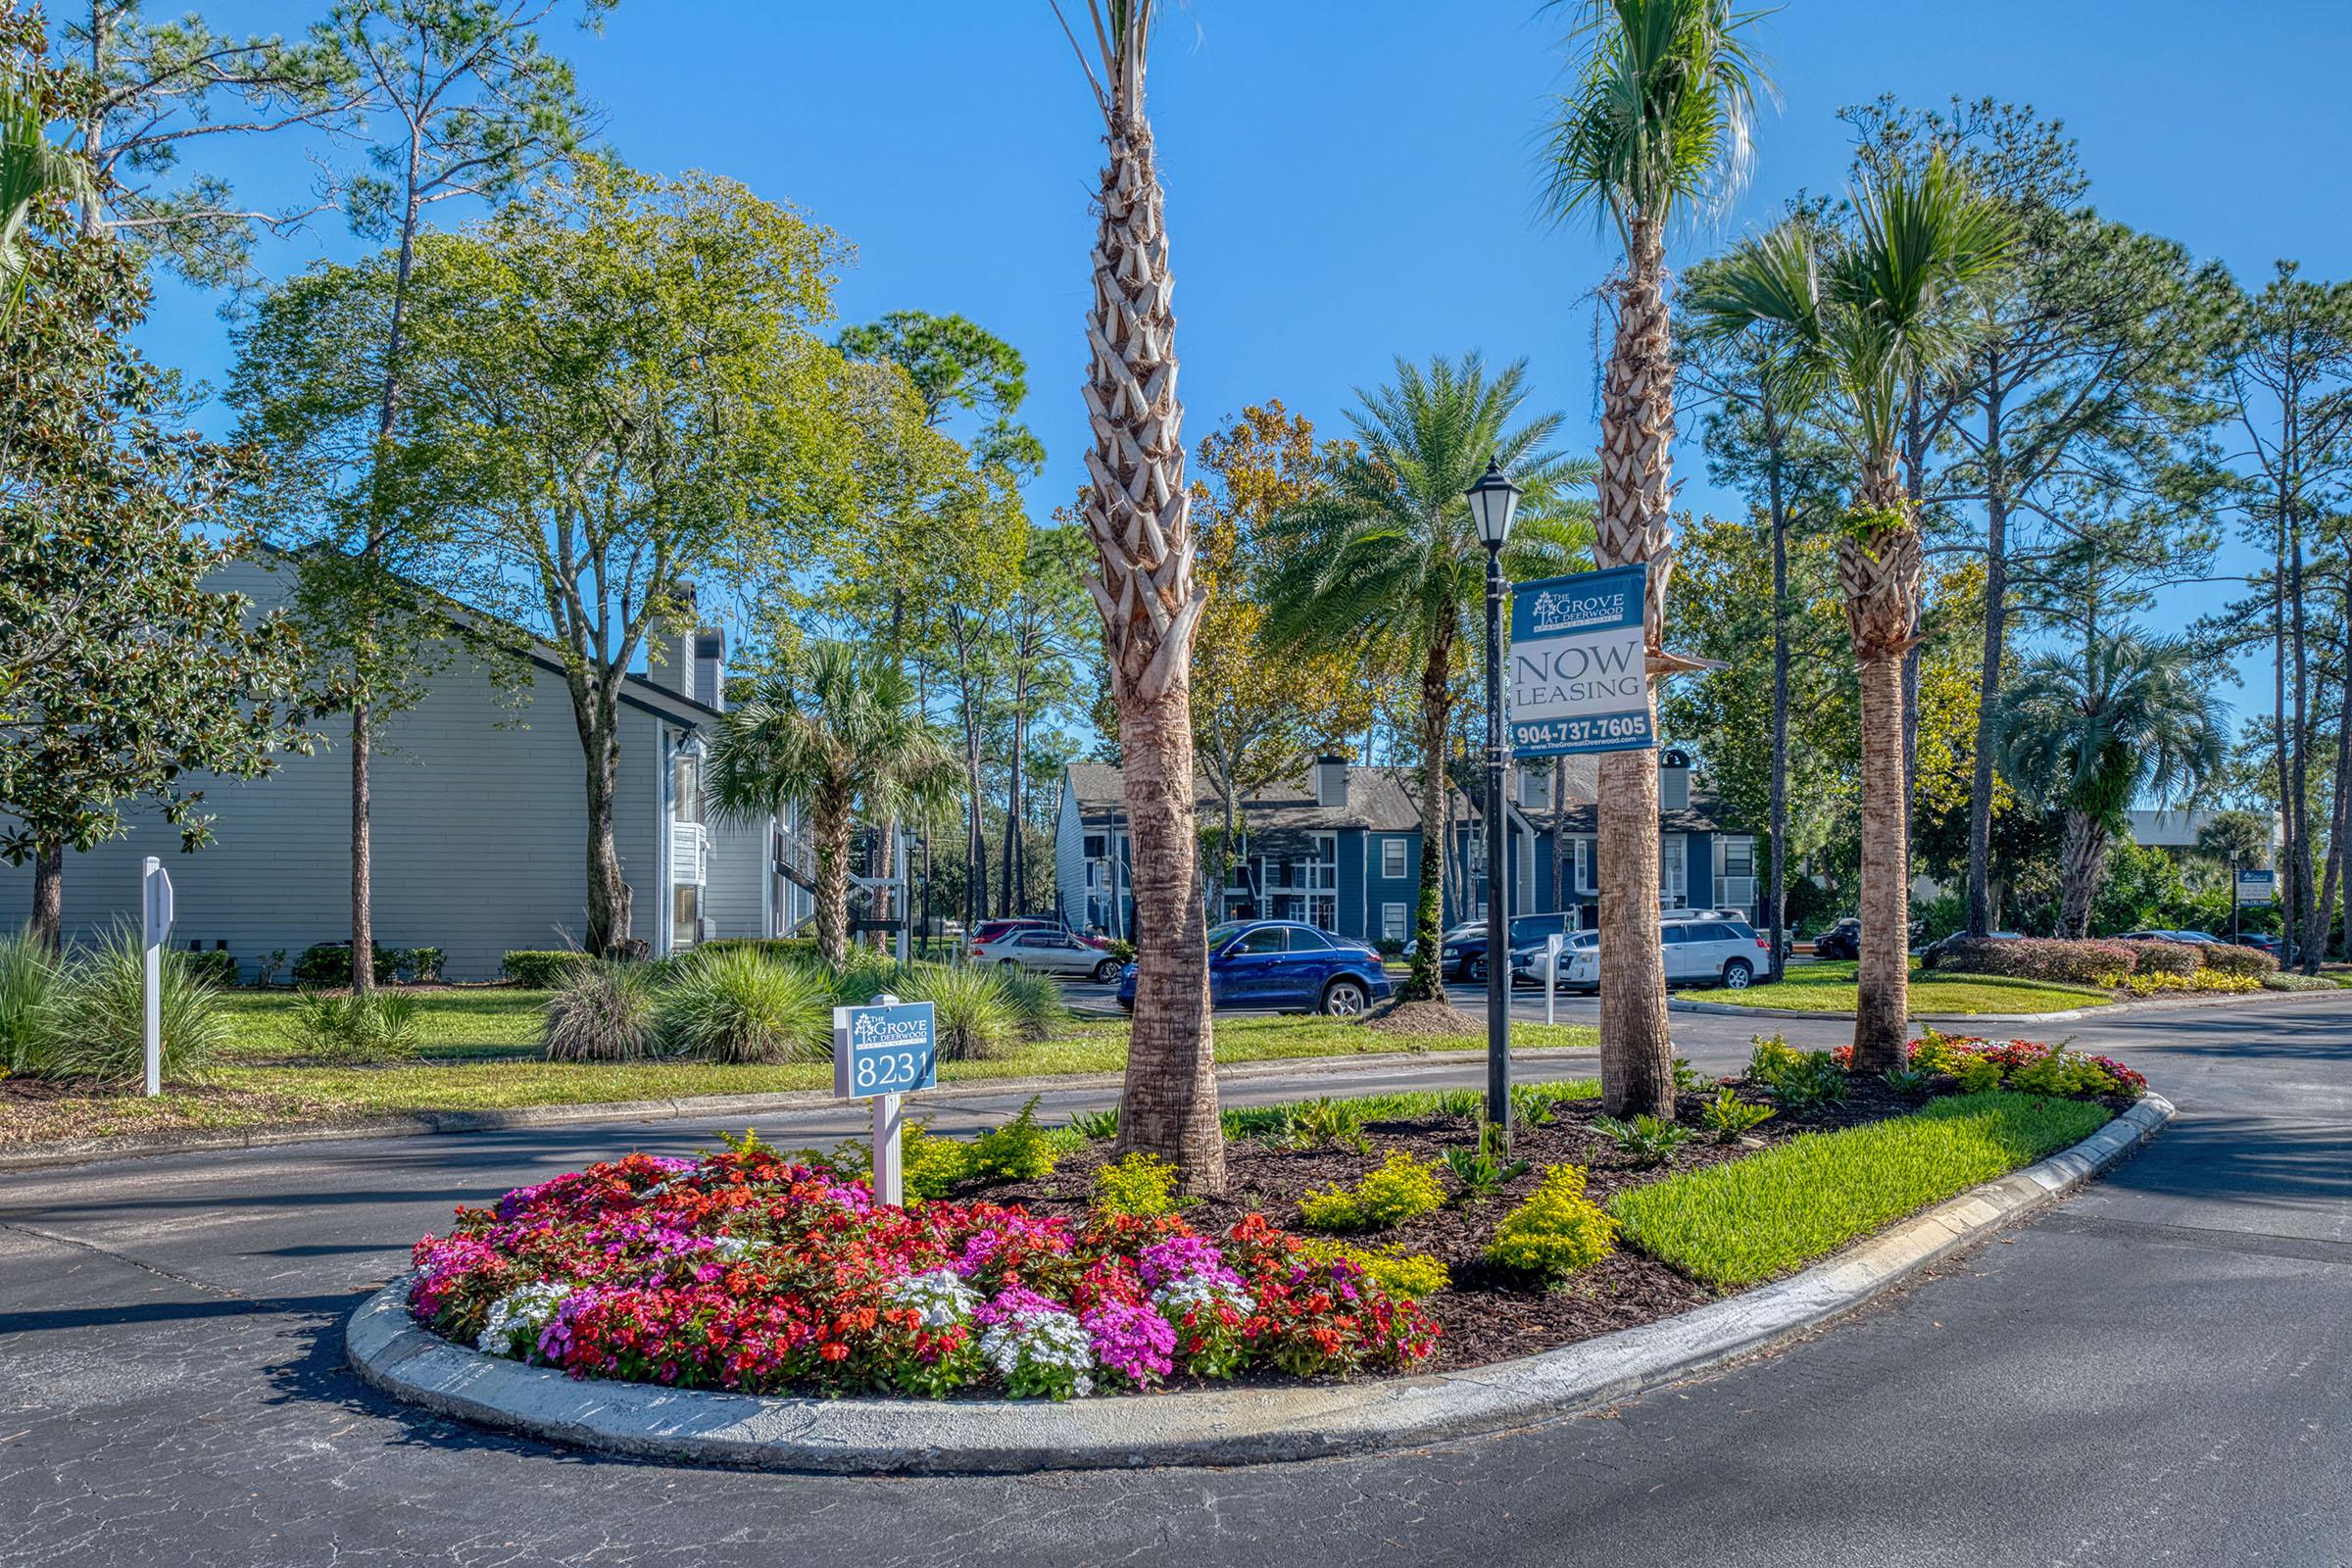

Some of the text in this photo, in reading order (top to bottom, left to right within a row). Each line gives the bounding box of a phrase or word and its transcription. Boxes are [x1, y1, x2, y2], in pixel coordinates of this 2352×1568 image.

[1553, 593, 1570, 602] THE
[1556, 593, 1624, 613] GROVE
[1545, 607, 1623, 624] AT DEERWOOD
[1516, 642, 1639, 684] NOW
[1516, 676, 1640, 707] LEASING
[1517, 716, 1646, 745] 904-737-7605
[1530, 736, 1637, 751] www.TheGroveatDeerwood.com
[874, 1020, 927, 1035] GROVE
[880, 1031, 927, 1042] DEERWOOD
[858, 1052, 929, 1087] 8231
